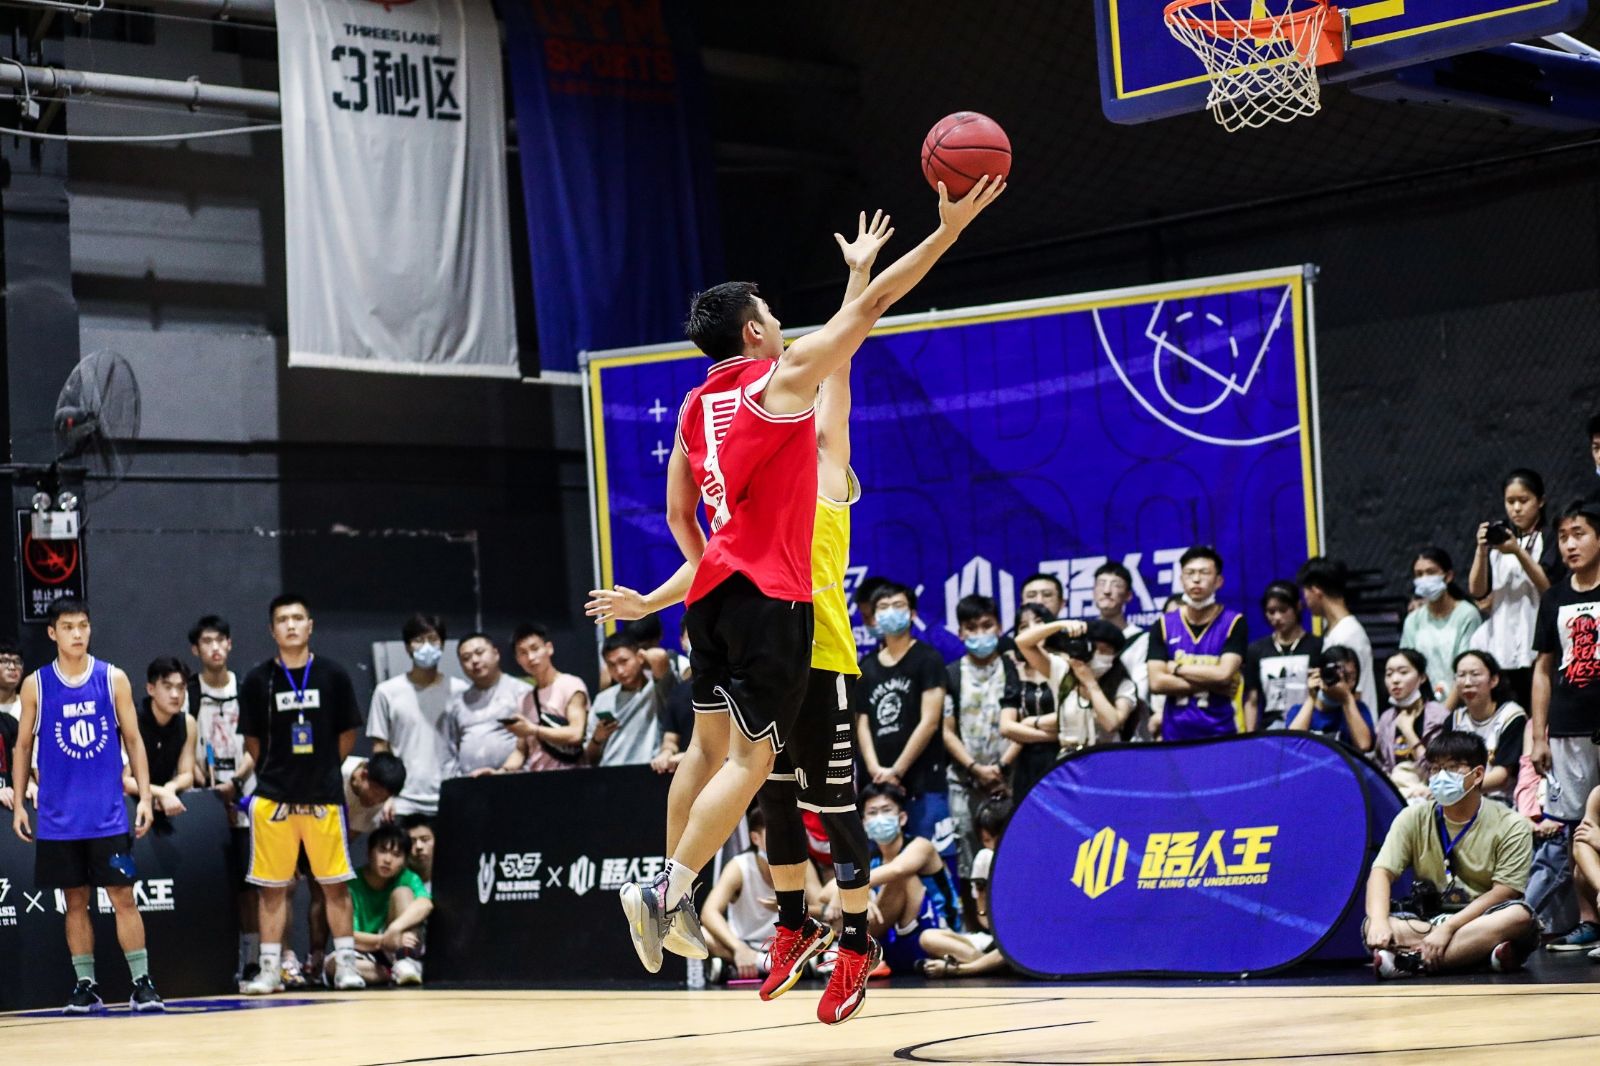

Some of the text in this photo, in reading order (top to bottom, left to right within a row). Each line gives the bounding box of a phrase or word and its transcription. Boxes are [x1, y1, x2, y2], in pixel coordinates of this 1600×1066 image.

[343, 23, 441, 46] THREES LANE
[331, 45, 462, 121] 3秒区
[1138, 825, 1279, 879] 路人王
[600, 856, 665, 885] 路人王
[1137, 873, 1268, 889] THE KING OF UNDERDOGS
